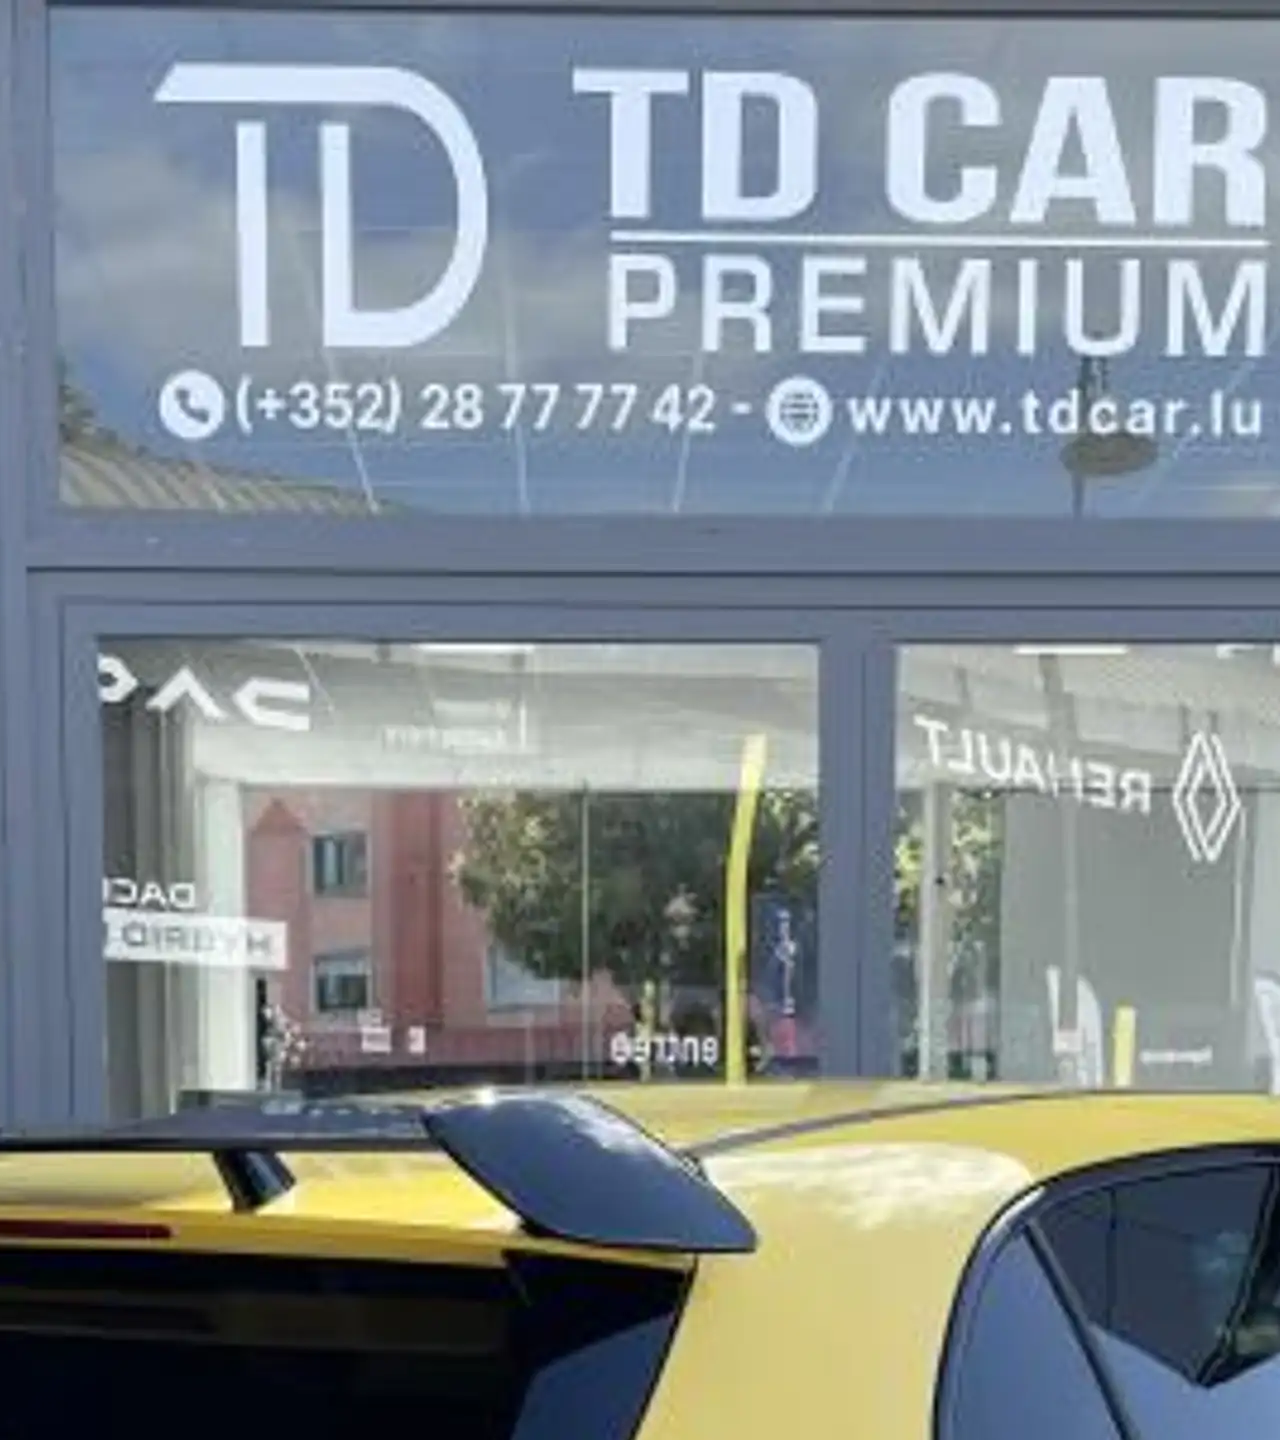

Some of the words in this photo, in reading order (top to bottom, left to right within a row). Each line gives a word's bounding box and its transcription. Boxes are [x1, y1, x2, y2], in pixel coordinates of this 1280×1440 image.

[573, 69, 818, 221] TD
[885, 73, 1268, 226] CAR
[607, 252, 1268, 358] PREMIUM
[235, 377, 404, 434] (+352)
[420, 383, 485, 430] 28
[498, 383, 560, 430] 77
[573, 383, 636, 430] 77
[651, 383, 717, 431] 42
[848, 387, 1264, 438] www.tdcar.lu
